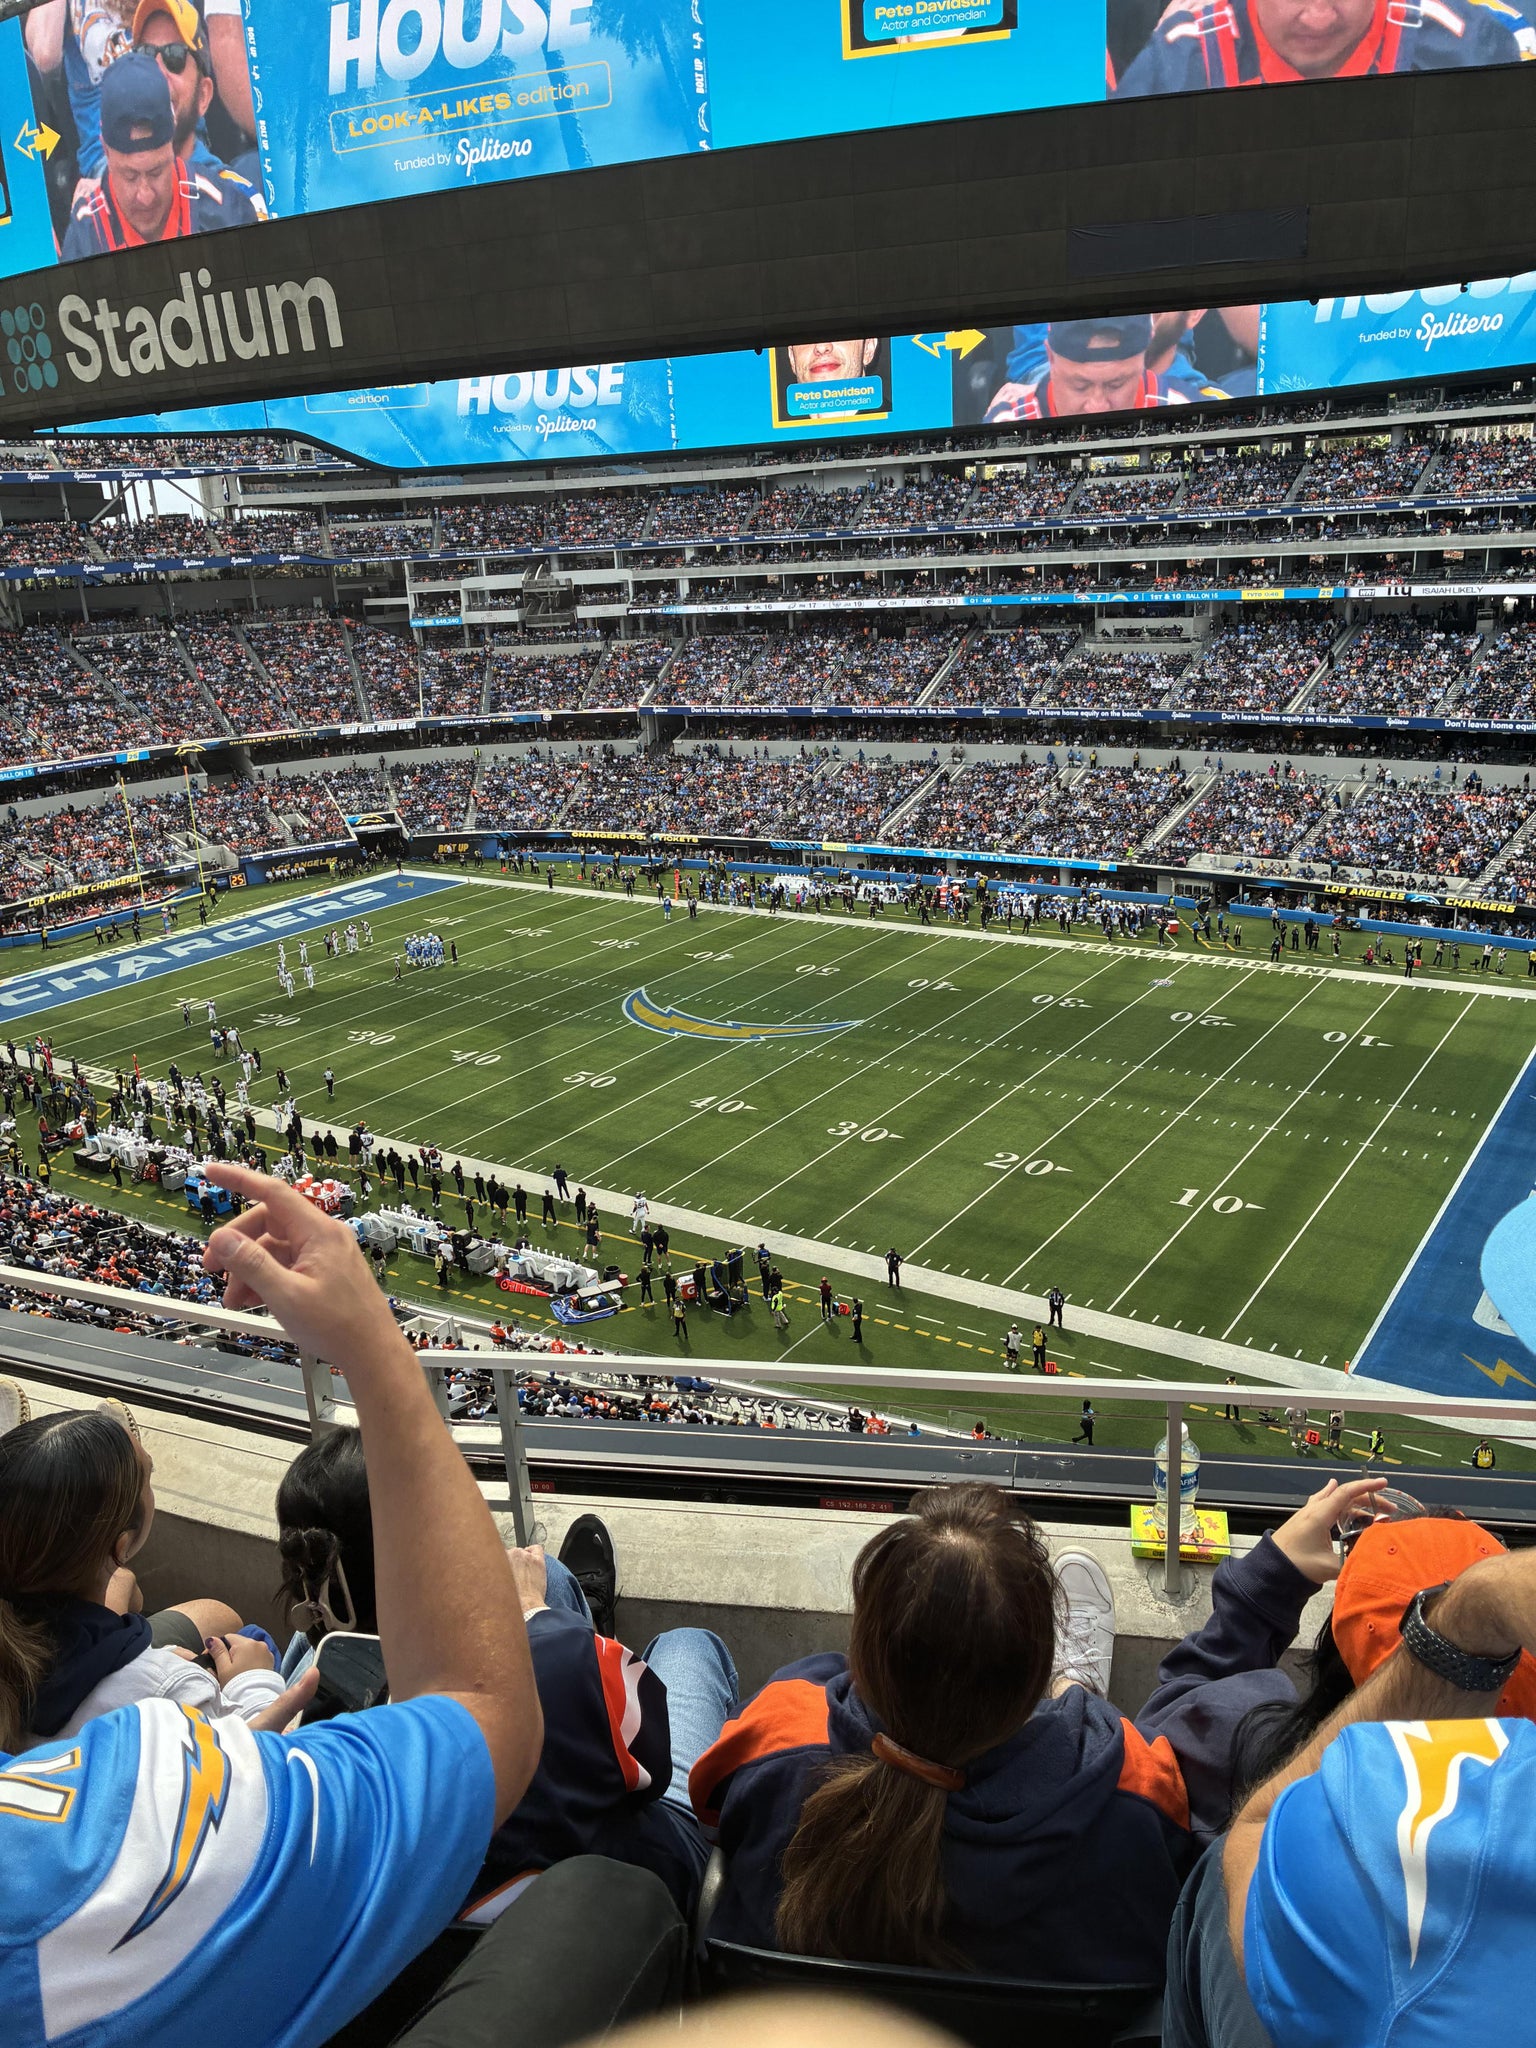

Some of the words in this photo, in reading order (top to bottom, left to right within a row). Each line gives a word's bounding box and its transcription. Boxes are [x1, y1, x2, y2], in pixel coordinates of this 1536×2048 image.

[874, 4, 914, 20] Pete
[915, 0, 991, 14] Davidson
[880, 19, 909, 31] Actor
[910, 16, 931, 27] and
[932, 9, 987, 24] Comedian
[247, 26, 257, 46] BOLT
[692, 31, 705, 50] LA
[327, 0, 594, 96] HOUSE
[251, 65, 260, 80] LA
[694, 57, 704, 72] UP
[695, 72, 705, 94] BOLT
[348, 92, 511, 138] LOOK-A-LIKES
[517, 81, 590, 106] edition
[259, 119, 268, 139] BOLT
[264, 158, 272, 173] LA
[394, 153, 435, 172] funded
[436, 151, 452, 166] by
[455, 137, 533, 177] Splitero
[58, 267, 344, 383] Stadium
[1358, 328, 1397, 343] funded
[1398, 327, 1412, 341] by
[1415, 312, 1505, 352] Splitero
[456, 362, 626, 416] HOUSE
[794, 391, 821, 402] Pete
[822, 385, 875, 399] Davidson
[348, 392, 390, 405] edition
[799, 401, 820, 410] Actor
[820, 400, 834, 408] and
[834, 396, 872, 407] Comedian
[492, 424, 521, 434] funded
[521, 423, 533, 433] by
[534, 414, 597, 442] Splitero
[1186, 592, 1200, 600] BALL
[1422, 586, 1451, 594] ISAIAH
[1452, 586, 1484, 594] LIKELY
[900, 708, 918, 716] equity
[1080, 710, 1100, 719] equity
[1110, 710, 1120, 718] the
[1122, 710, 1144, 718] bench.
[1221, 712, 1240, 720] Don't
[1241, 712, 1260, 722] leave
[1260, 714, 1280, 722] home
[1282, 714, 1304, 724] equity
[1316, 714, 1328, 722] the
[1328, 715, 1354, 724] bench.
[1444, 720, 1466, 728] Don't
[1468, 720, 1489, 729] leave
[1490, 720, 1514, 729] home
[229, 737, 266, 746] CHARGERS
[267, 734, 287, 742] SUITE
[288, 731, 318, 740] RENTALS
[458, 842, 469, 852] UP
[231, 874, 244, 885] 25
[28, 897, 46, 908] LOS
[48, 886, 89, 904] ANGELES
[90, 875, 140, 892] CHARGERS
[1324, 884, 1348, 894] LOS
[1350, 886, 1406, 901] ANGELES
[1445, 898, 1516, 914] CHARGERS
[0, 888, 388, 1006] CHARGERS
[598, 938, 641, 950] 30
[1070, 942, 1171, 958] CANCER
[692, 950, 735, 962] 40
[1181, 954, 1332, 975] INTERCEPT
[795, 963, 841, 977] 50
[907, 977, 953, 991] 40
[1031, 993, 1085, 1009] 30
[259, 1012, 301, 1028] 20
[1170, 1010, 1226, 1027] 20
[351, 1029, 396, 1047] 30
[1322, 1030, 1382, 1047] 10
[455, 1049, 502, 1068] 40
[562, 1070, 617, 1089] 50
[688, 1094, 745, 1114] 40
[826, 1120, 890, 1143] 30
[983, 1151, 1056, 1176] 20
[1168, 1187, 1245, 1215] 10
[1047, 1364, 1055, 1373] 10
[1308, 1432, 1318, 1443] G
[1162, 1475, 1197, 1486] AAFINA
